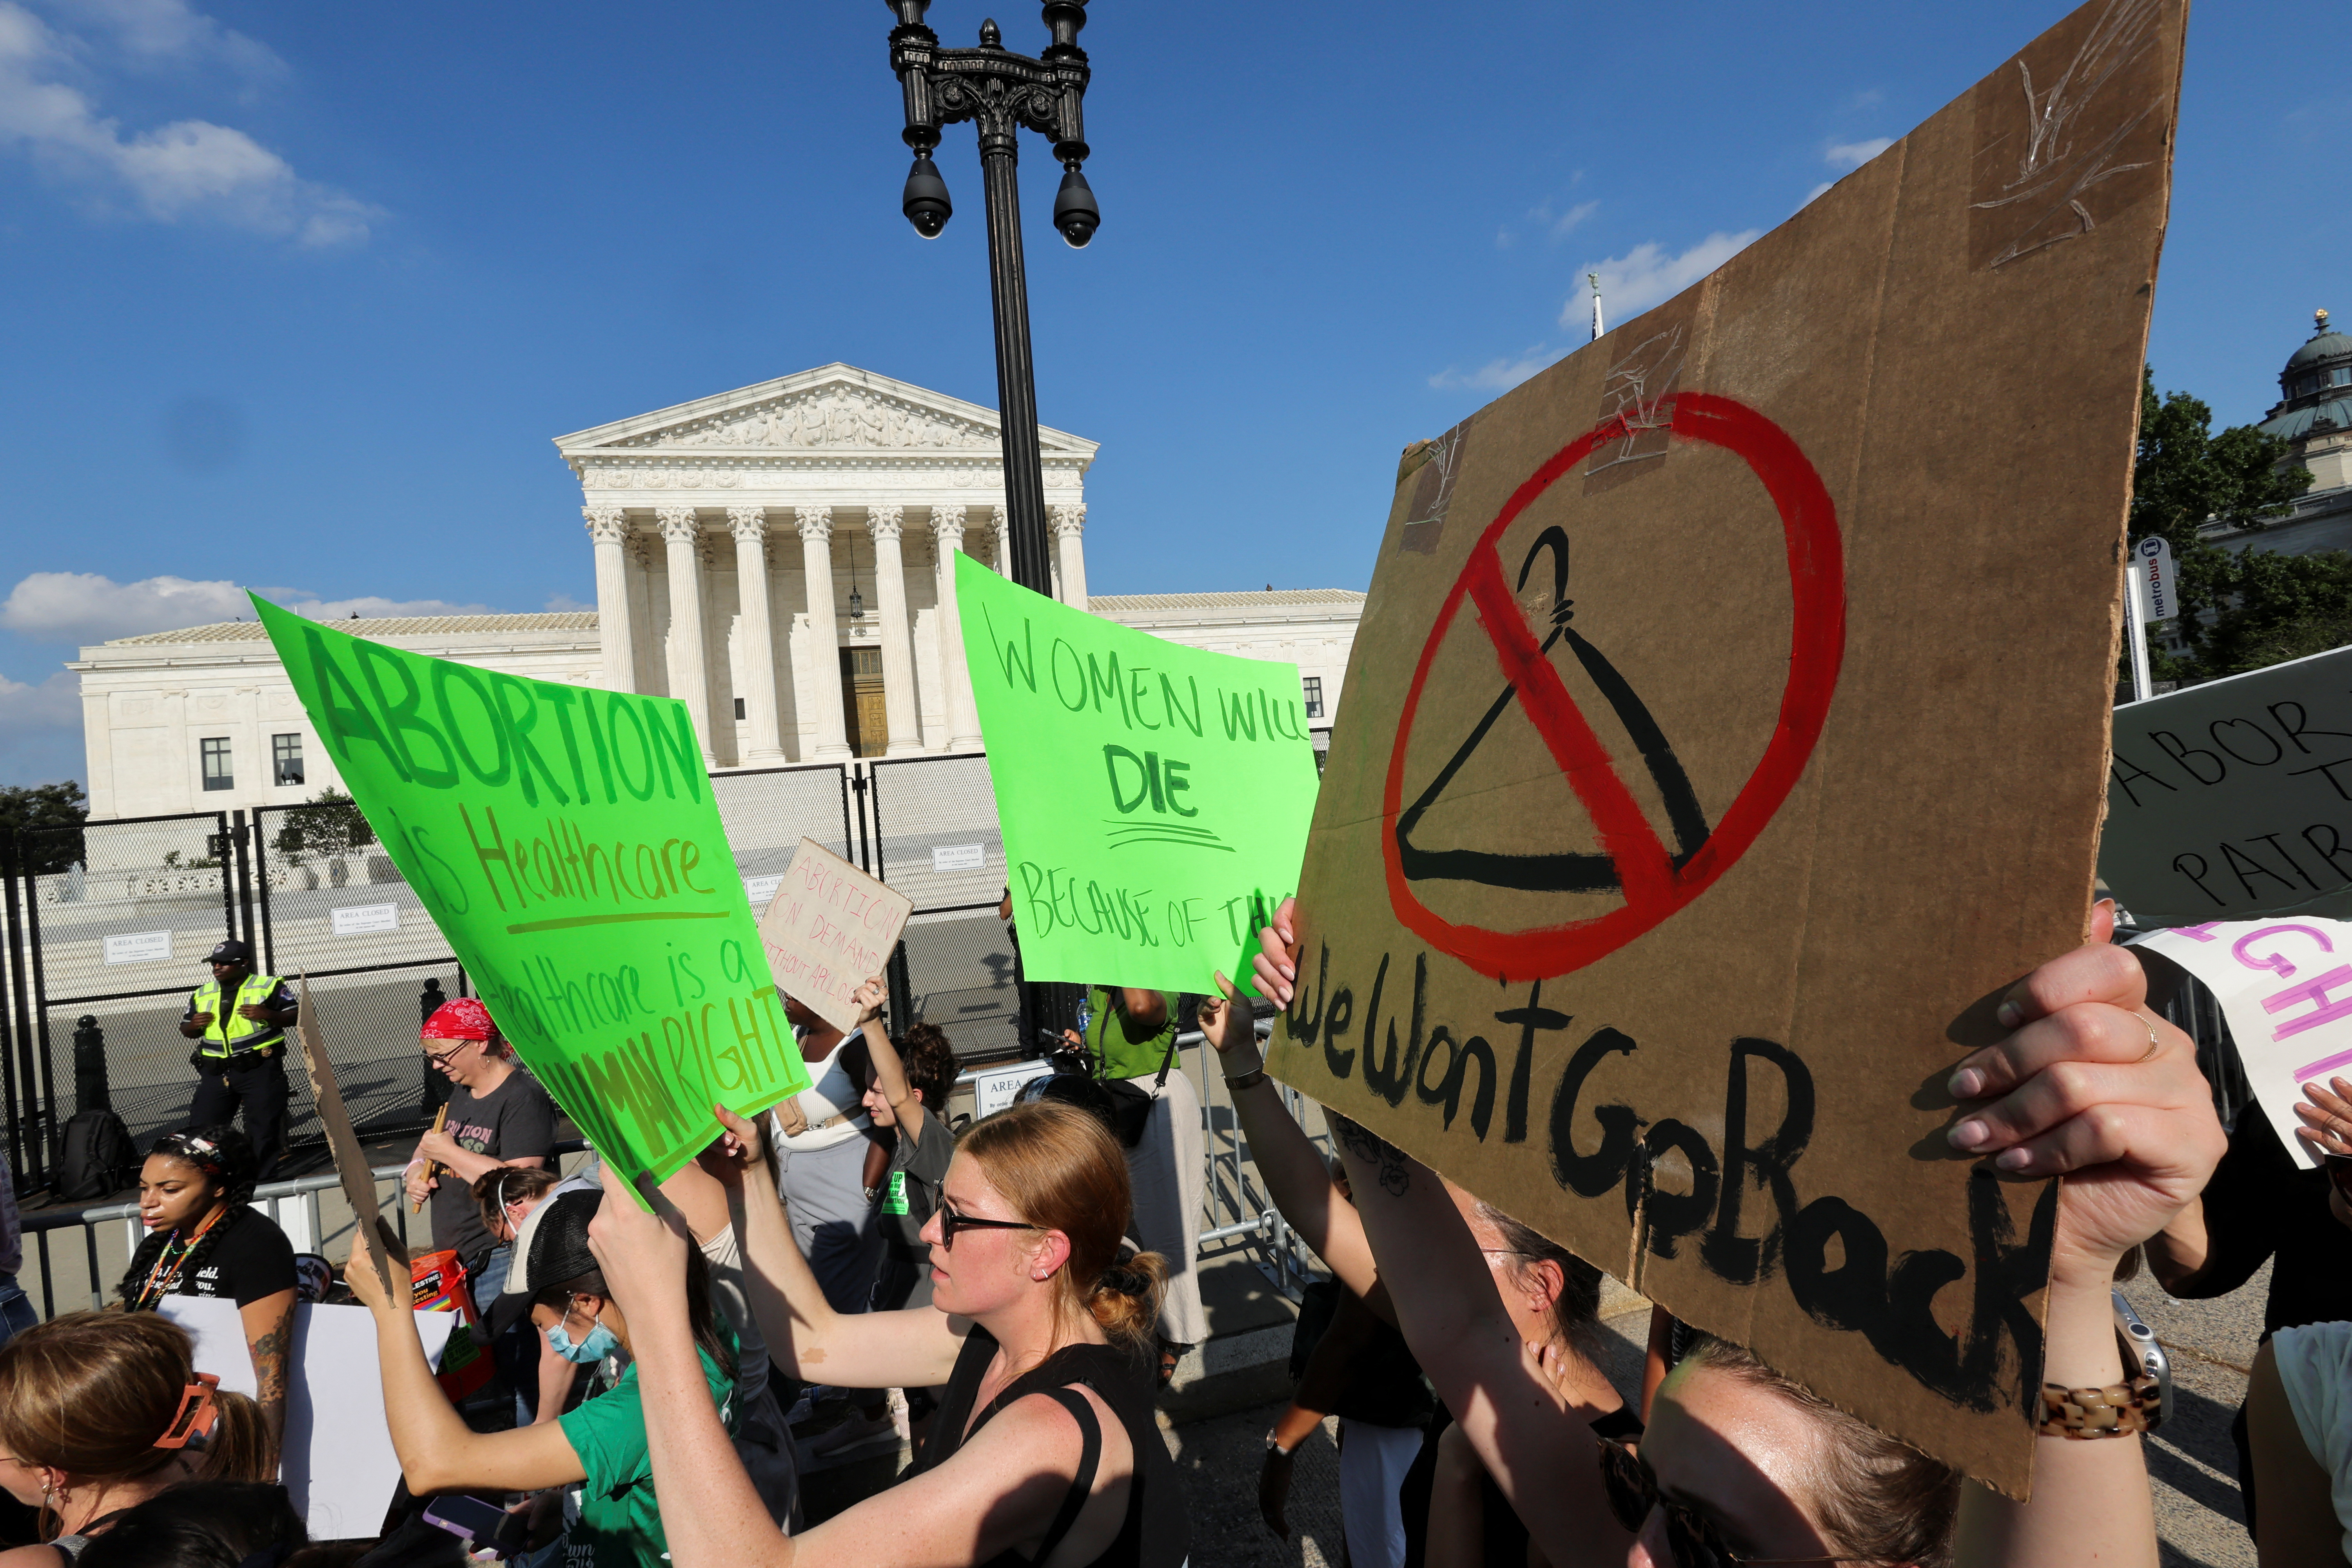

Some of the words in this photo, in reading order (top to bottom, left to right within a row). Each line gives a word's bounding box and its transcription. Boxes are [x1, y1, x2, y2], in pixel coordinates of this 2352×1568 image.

[752, 475, 800, 485] EQUAL
[803, 474, 857, 485] JUSTICE
[863, 474, 909, 484] UNDER
[913, 474, 938, 484] LAW
[2149, 558, 2165, 617] metrobus
[982, 602, 1203, 738] WOMEN
[1218, 687, 1310, 741] WILL
[301, 626, 701, 808] ABORTION
[2111, 688, 2352, 807] ABOR
[1102, 744, 1198, 817] DIE
[388, 806, 469, 915] is
[459, 802, 716, 913] Healthcare
[792, 857, 900, 941] ABORTION
[773, 893, 803, 925] ON
[809, 914, 879, 974] DEMAND
[1017, 862, 1159, 947] BECAUSE
[1167, 897, 1208, 947] OF
[460, 948, 656, 1045] Healthcare
[666, 942, 706, 1008] is
[720, 939, 757, 991] a
[661, 985, 794, 1123] RIGHT
[990, 1079, 1022, 1093] AREA
[894, 1174, 903, 1183] UP
[1286, 934, 1356, 1080] We
[1549, 1027, 1722, 1259] Go
[1699, 1036, 2063, 1428] Back
[196, 1266, 219, 1279] ield.
